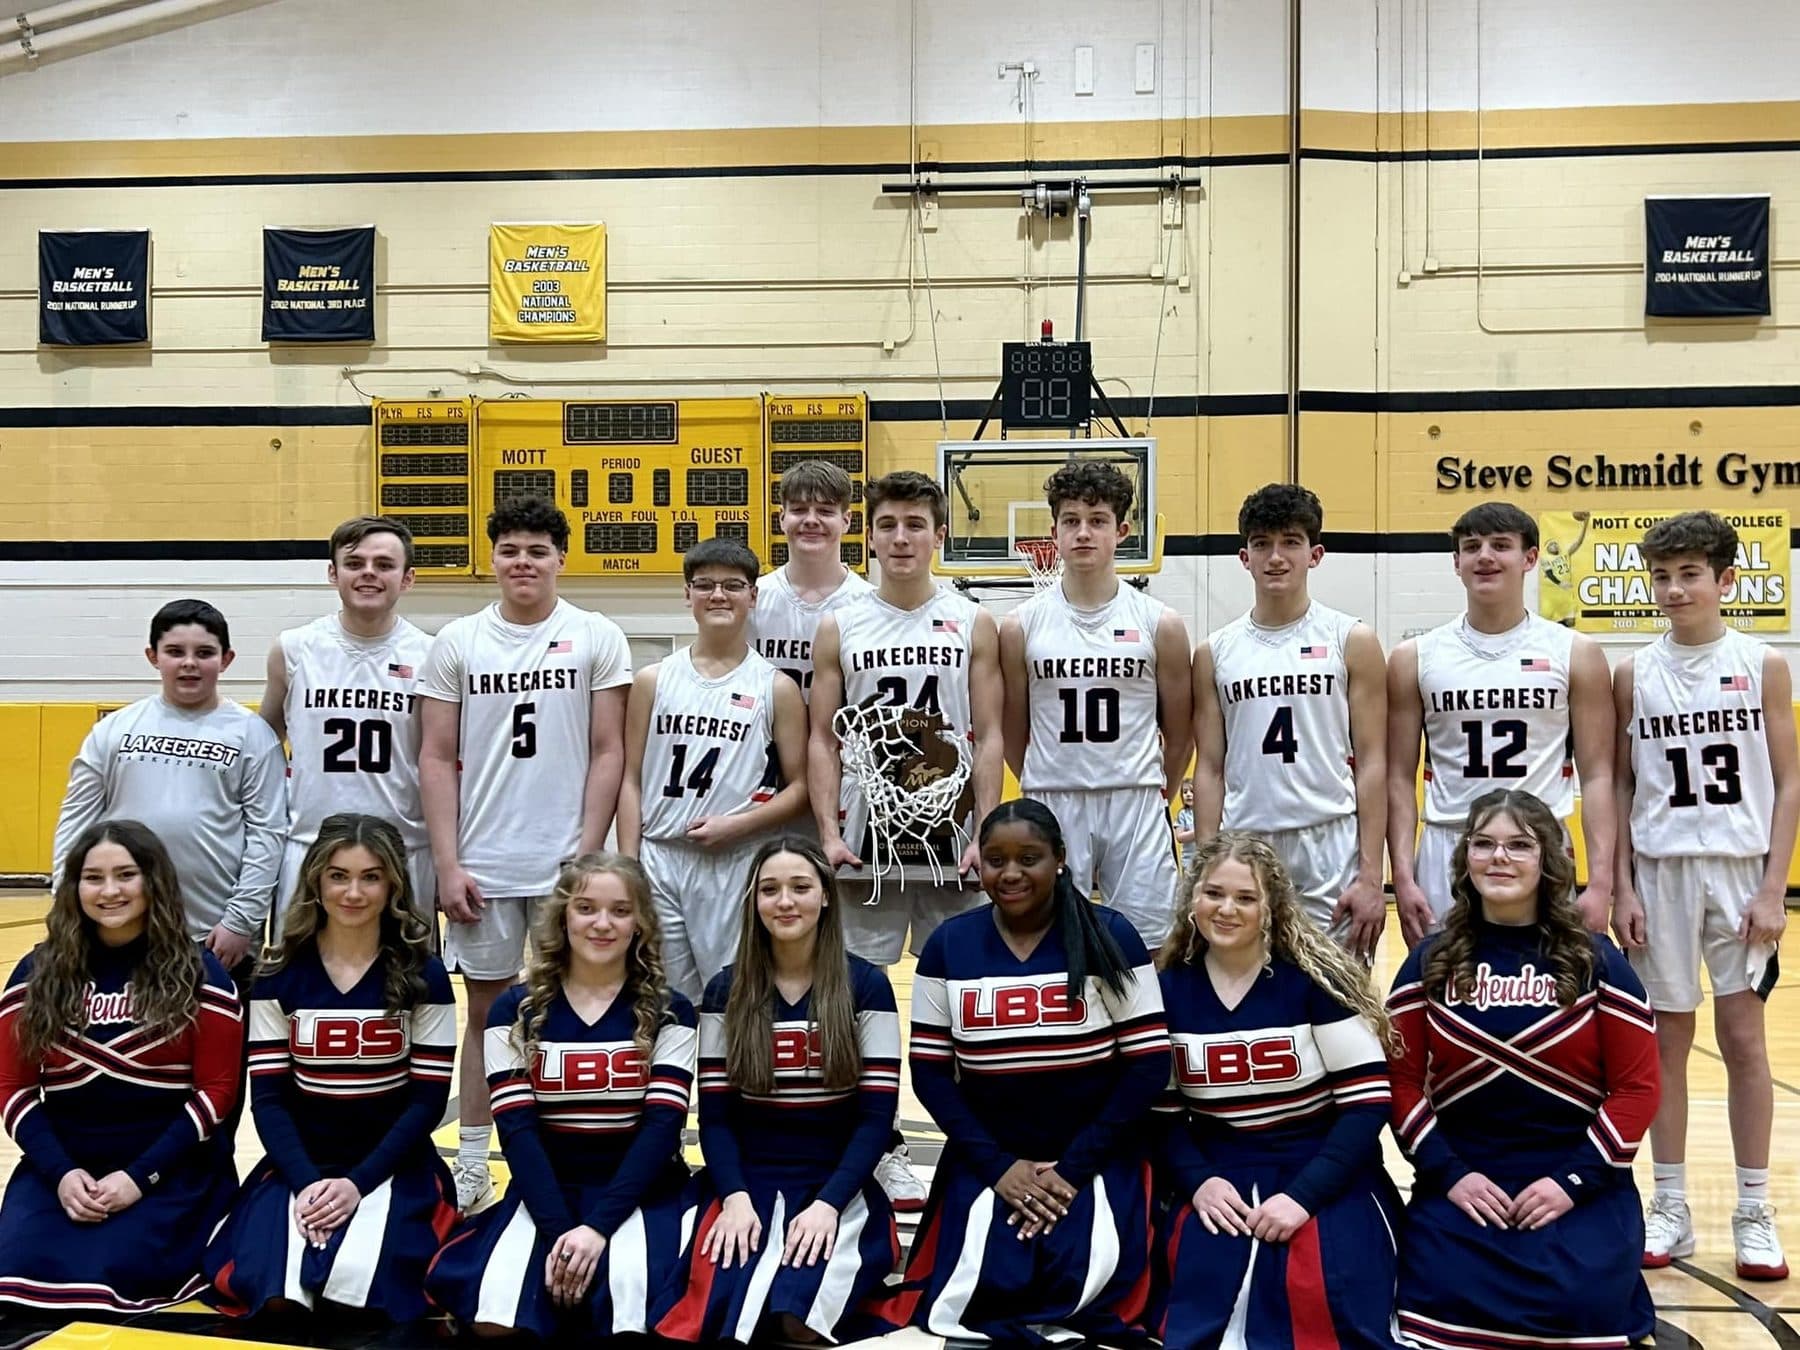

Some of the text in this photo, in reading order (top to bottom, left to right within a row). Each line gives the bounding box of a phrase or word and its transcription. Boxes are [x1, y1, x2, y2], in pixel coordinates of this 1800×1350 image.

[1685, 236, 1731, 249] MEN'S
[526, 246, 569, 259] MEN'S
[1663, 251, 1755, 263] BASKETBALL
[73, 267, 114, 279] MEN'S
[298, 265, 340, 278] MEN'S
[504, 260, 590, 273] BASKETBALL
[1678, 272, 1716, 282] NATIONAL
[53, 281, 133, 292] BASKETBALL
[277, 280, 359, 291] BASKETBALL
[533, 280, 560, 293] 2003
[65, 301, 99, 310] NATIONAL
[290, 300, 325, 309] NATIONAL
[344, 298, 366, 308] PLACE
[522, 295, 571, 308] NATIONAL
[518, 310, 576, 323] CHAMPIONS
[380, 407, 463, 418] PLYR FLS PTS
[770, 403, 854, 415] PLYR FLS PTS
[502, 449, 546, 464] MOTT
[691, 448, 742, 463] GUEST
[601, 458, 640, 469] PERIOD
[1436, 453, 1800, 493] Steve Schmidt Gym
[582, 511, 659, 522] PLAYER FOUL
[715, 510, 749, 521] FOULS
[1592, 518, 1629, 529] MOTT
[603, 559, 640, 570] MATCH
[755, 638, 813, 660] LAKEC
[852, 646, 964, 672] LAKECREST
[1033, 657, 1147, 679] LAKECREST
[469, 668, 577, 695] LAKECREST
[1223, 674, 1335, 705] LAKECREST
[304, 688, 416, 714] LAKECREST
[1431, 688, 1559, 713] LAKECREST
[1058, 688, 1120, 743] 10
[512, 702, 536, 758] 5
[656, 714, 751, 742] LAKECREST
[1638, 708, 1762, 740] LAKECREST
[1262, 706, 1299, 764] 4
[119, 733, 240, 767] LAKECREST
[323, 717, 392, 774] 20
[1461, 720, 1528, 778] 12
[662, 743, 721, 799] 14
[1665, 743, 1742, 808] 13
[960, 983, 1088, 1031] LBS
[289, 1015, 406, 1059] LBS
[1172, 1036, 1301, 1087] LBS
[532, 1048, 648, 1094] LBS
